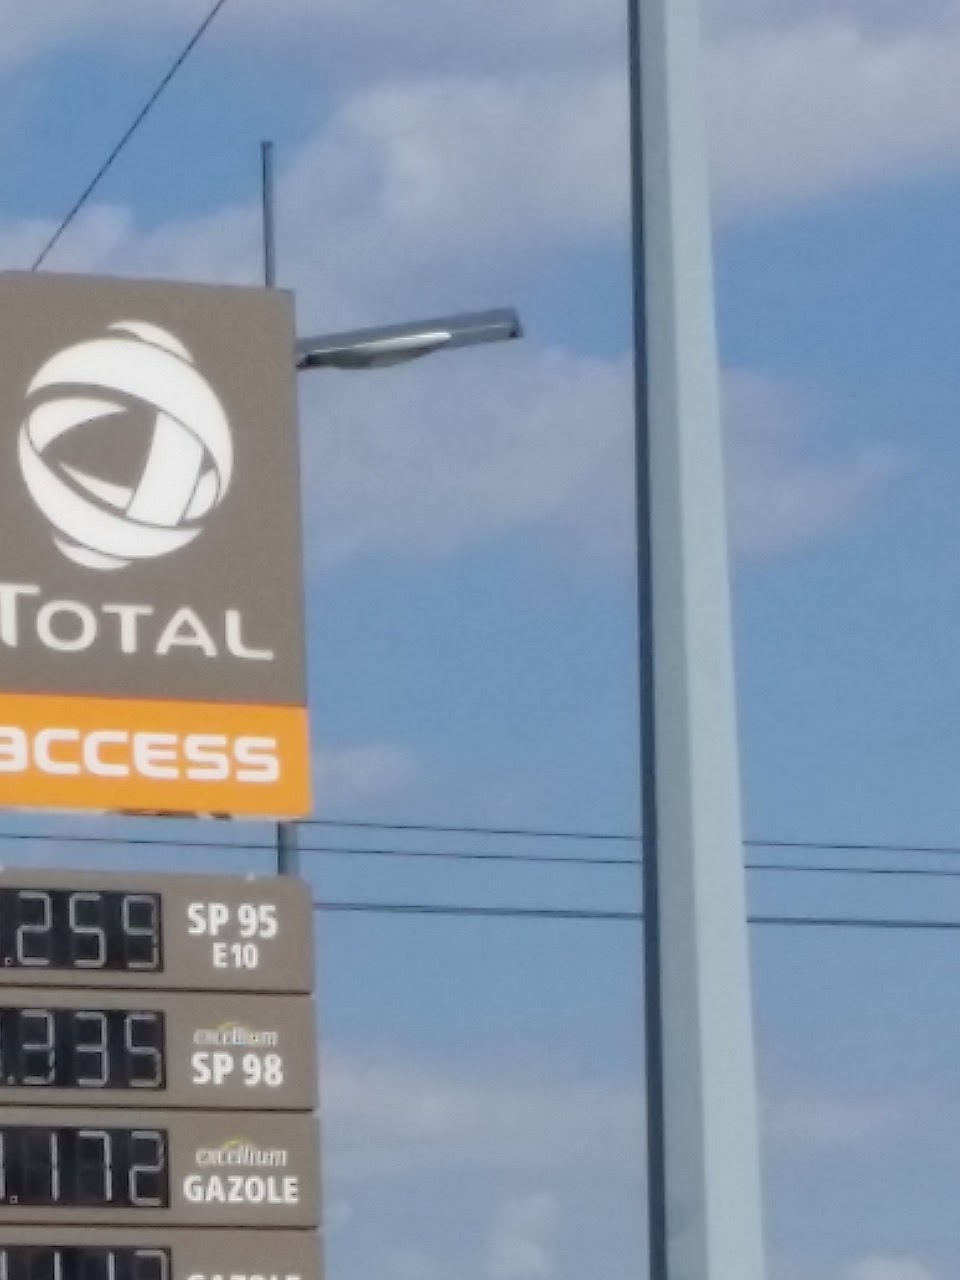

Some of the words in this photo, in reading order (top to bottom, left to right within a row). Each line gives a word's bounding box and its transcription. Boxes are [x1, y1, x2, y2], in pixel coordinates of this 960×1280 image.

[187, 903, 229, 936] SP
[238, 904, 278, 938] 95
[191, 1052, 234, 1085] SP
[243, 1053, 283, 1087] 98
[183, 1175, 299, 1204] GAZOLE
